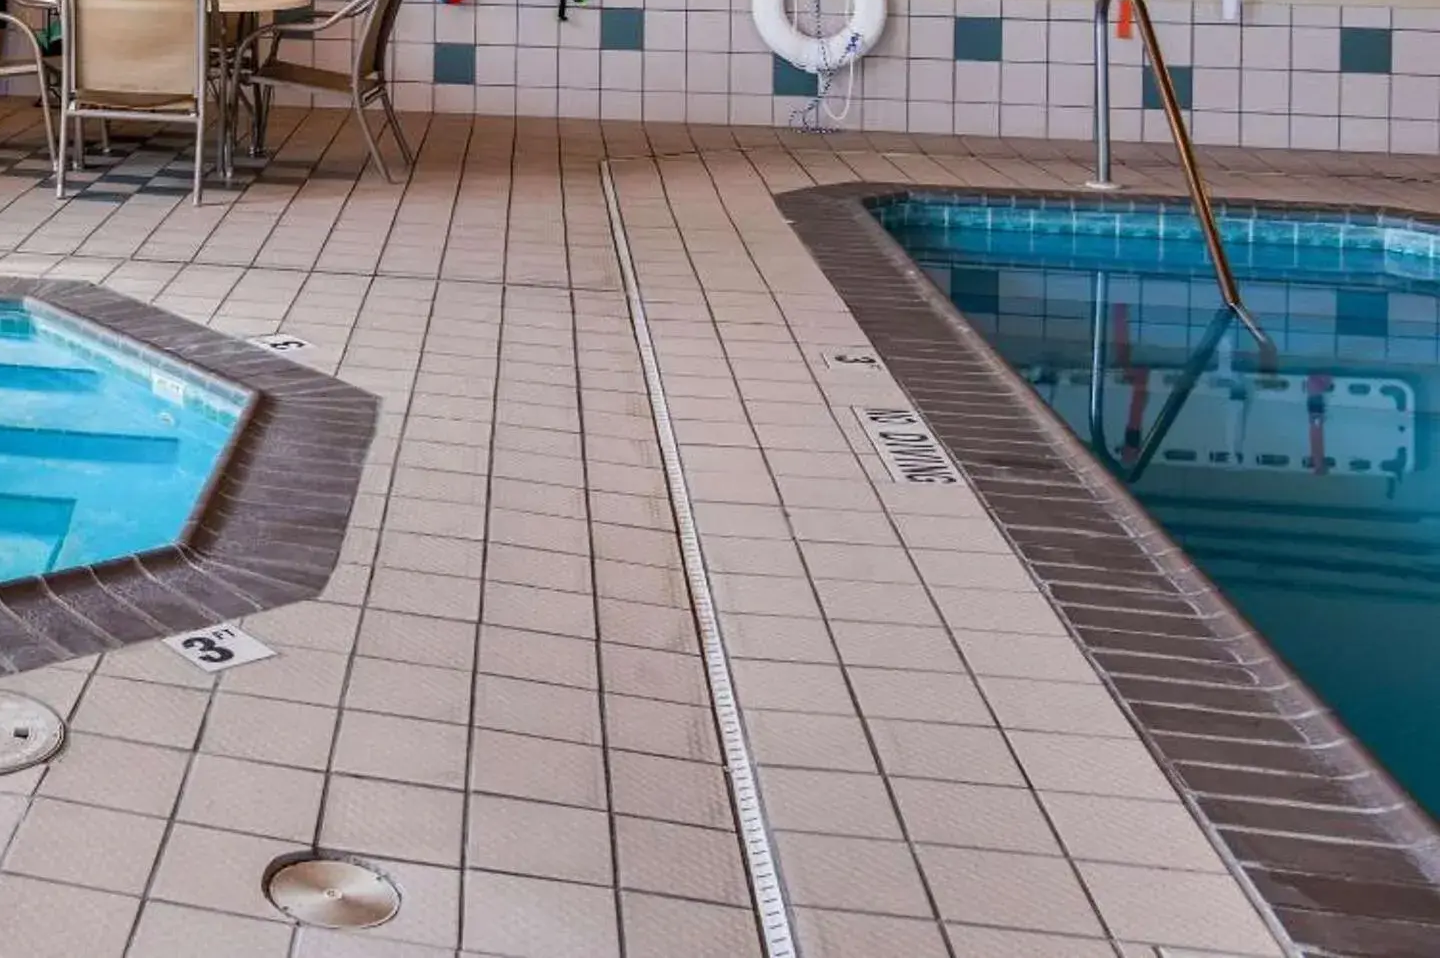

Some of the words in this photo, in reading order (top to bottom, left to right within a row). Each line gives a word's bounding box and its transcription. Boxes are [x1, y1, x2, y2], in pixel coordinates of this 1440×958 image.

[864, 408, 918, 425] NO
[878, 431, 958, 484] DIVING
[181, 636, 235, 663] 3
[211, 628, 236, 640] FT
